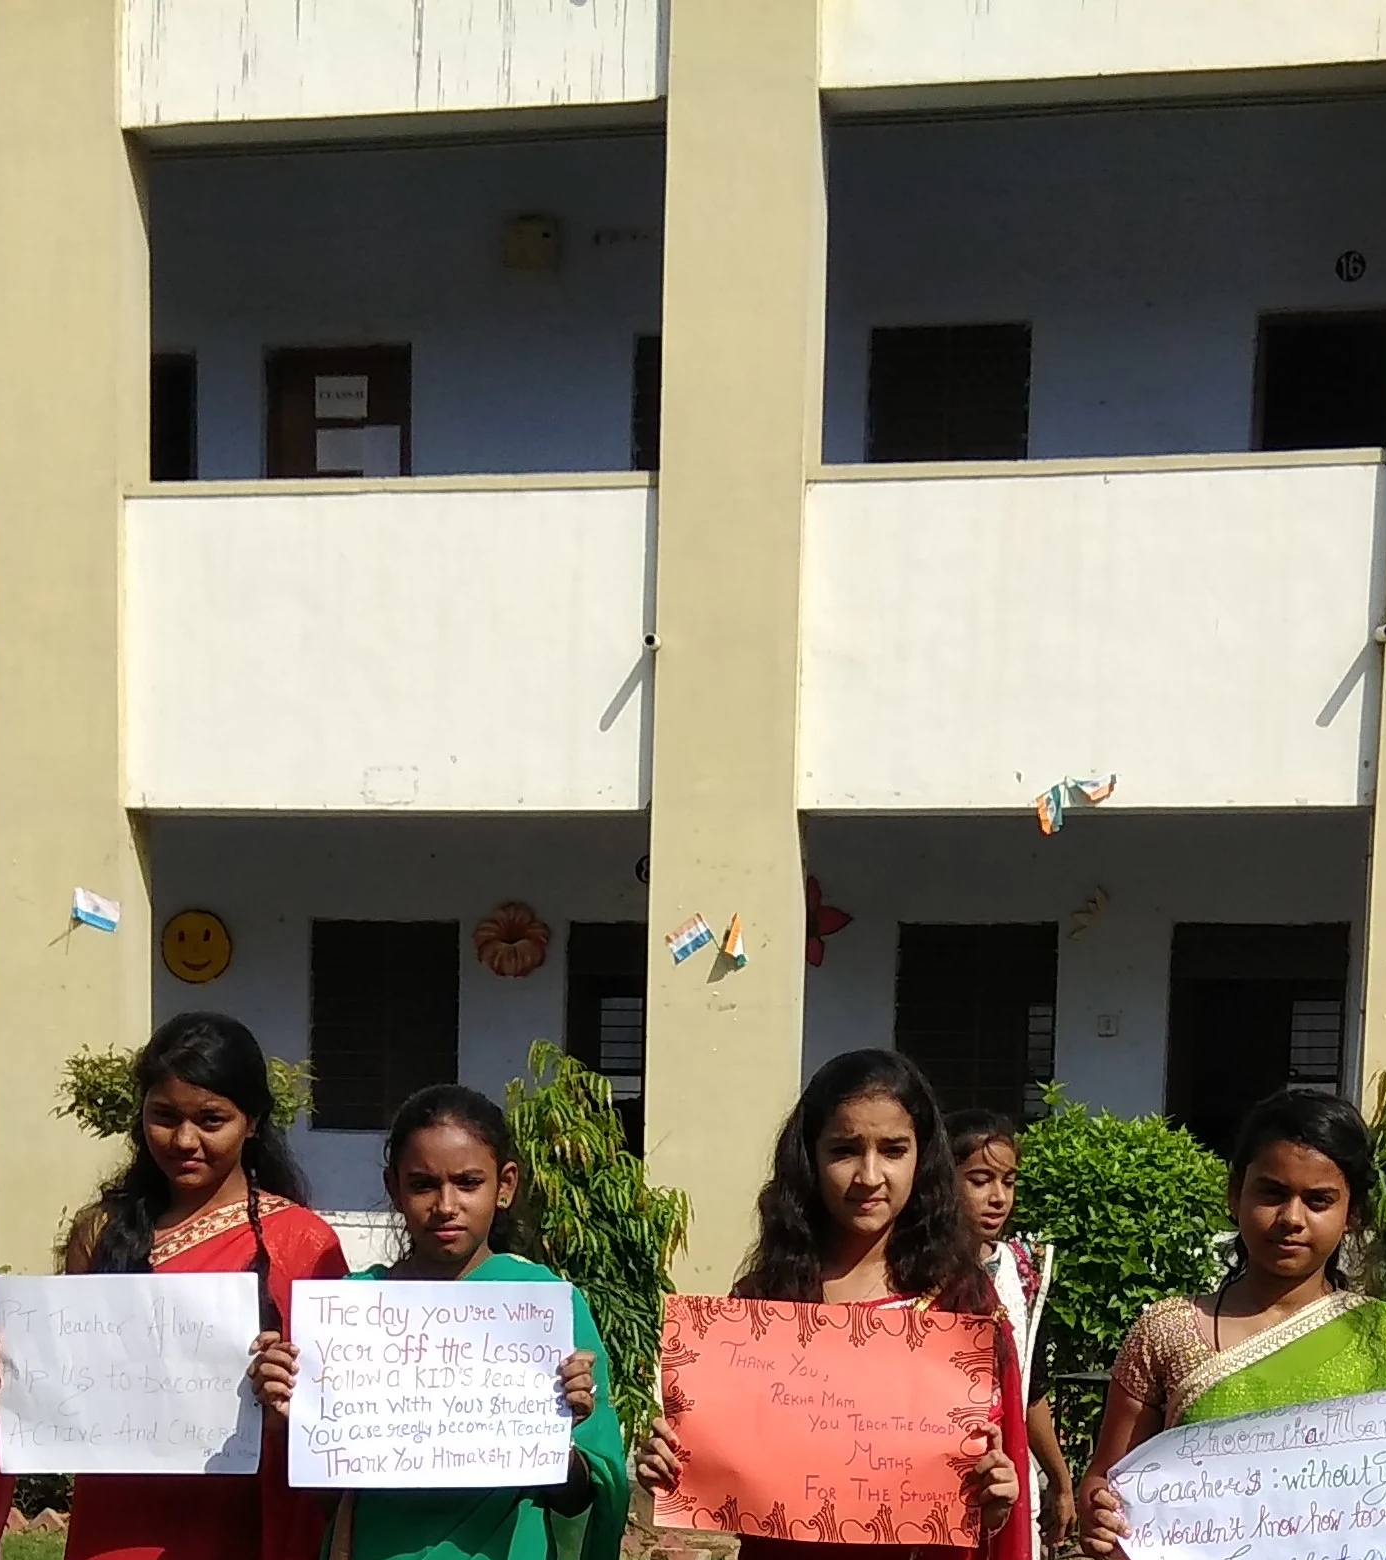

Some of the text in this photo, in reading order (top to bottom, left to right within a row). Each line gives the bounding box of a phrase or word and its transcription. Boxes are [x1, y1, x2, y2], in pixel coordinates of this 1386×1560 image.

[1341, 253, 1363, 281] 16
[309, 1294, 360, 1327] The
[366, 1292, 410, 1337] day
[383, 1333, 430, 1366] off
[434, 1337, 474, 1367] the
[482, 1332, 563, 1364] Lesson
[138, 1364, 235, 1395] become
[311, 1366, 381, 1394] follow
[414, 1366, 474, 1390] KID'S
[479, 1366, 526, 1389] lead
[319, 1396, 378, 1422] Learn
[300, 1423, 343, 1447] You
[348, 1422, 383, 1439] are
[386, 1420, 433, 1444] really
[310, 1442, 566, 1479] Thank You Himakshi Mam
